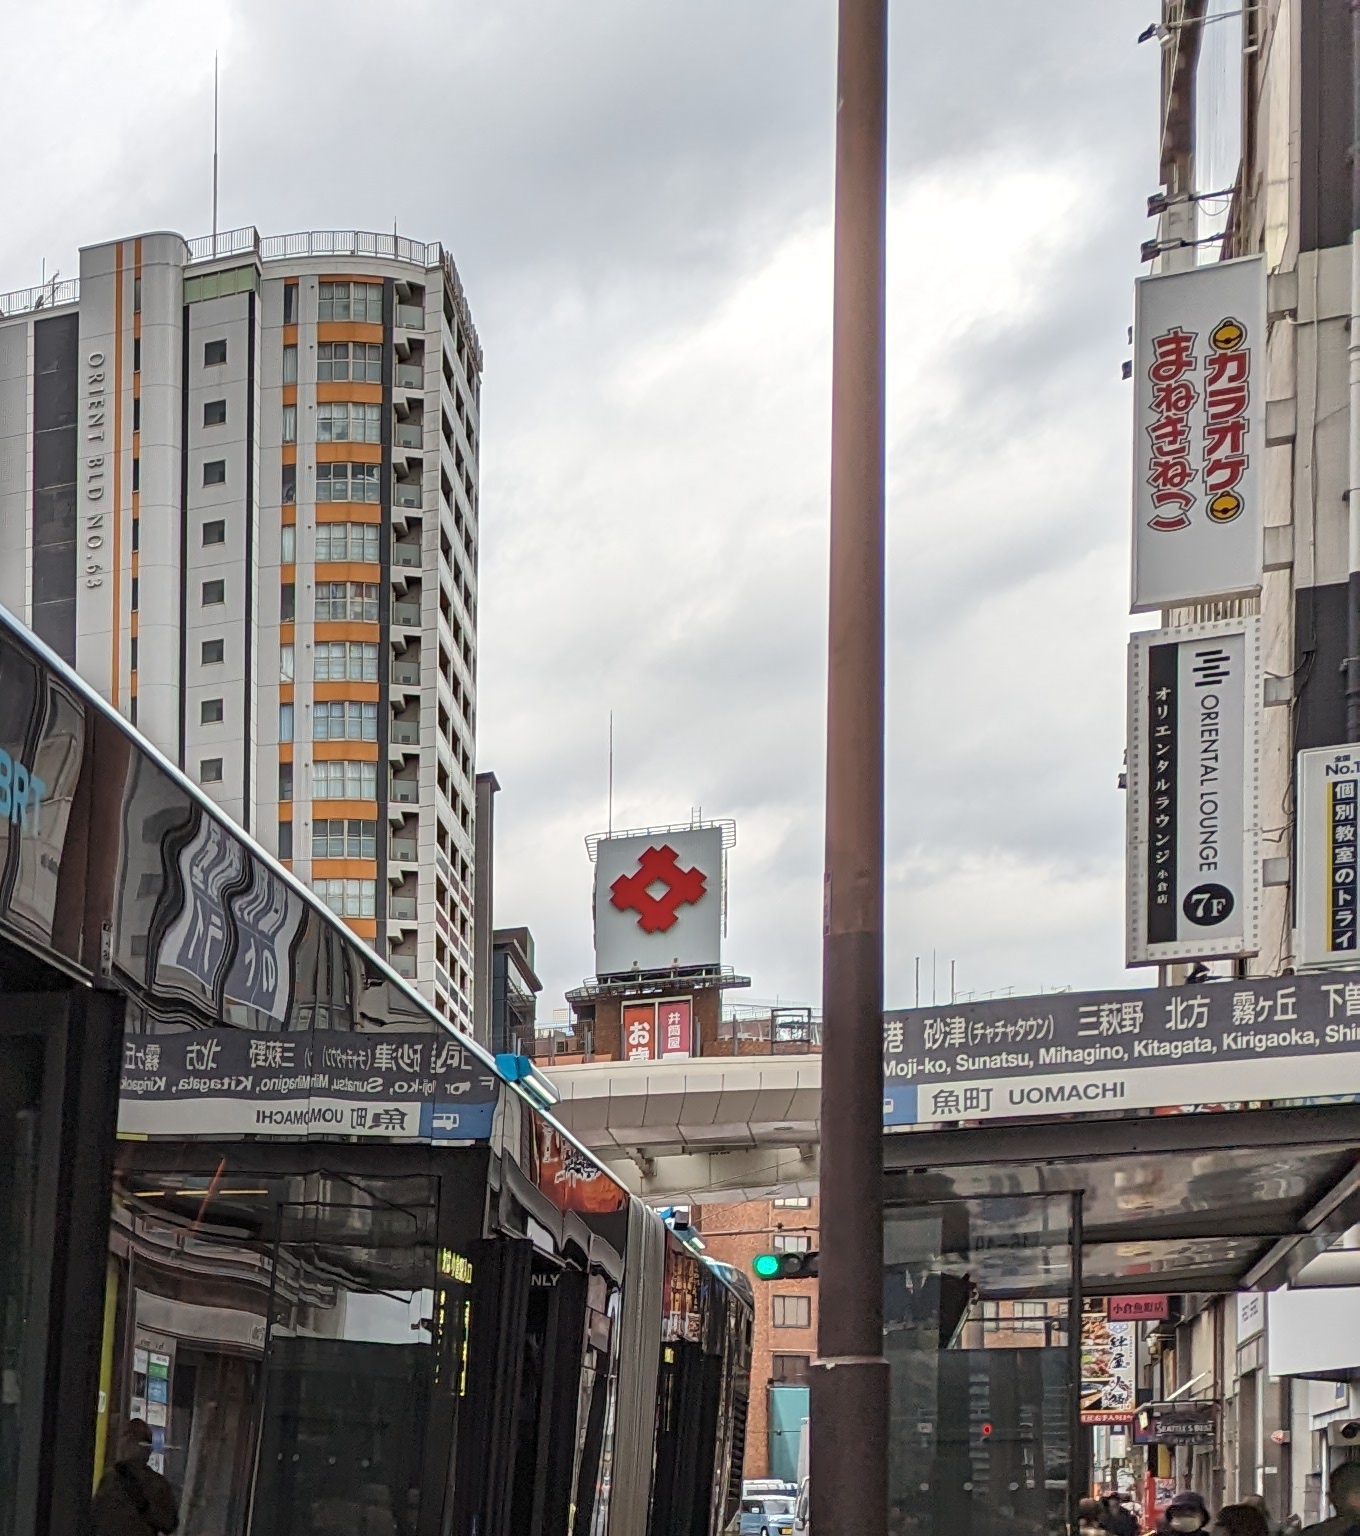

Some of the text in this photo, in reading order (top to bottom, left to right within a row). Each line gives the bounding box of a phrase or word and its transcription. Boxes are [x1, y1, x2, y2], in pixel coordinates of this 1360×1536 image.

[86, 352, 106, 590] ORIENT BLD NO.63
[1147, 326, 1199, 532] まねきねこ
[1203, 348, 1252, 496] カラオケ
[1154, 685, 1173, 905] オリエンタルラウンジ 小倉店
[1199, 693, 1220, 873] ORIENTAL LOUNGE
[1190, 892, 1227, 919] 7F
[1334, 782, 1356, 950] 個別教室のトライ
[923, 1015, 1055, 1050] 砂津(チャチャタウン)
[1077, 1001, 1144, 1037] 三萩野
[1165, 994, 1211, 1031] 北方
[956, 1052, 1034, 1072] Sunatsu,
[1039, 1043, 1129, 1066] Mihagino,
[1134, 1037, 1218, 1058] Kitagata,
[1223, 1028, 1320, 1052] Kirigaoka,
[1008, 1081, 1126, 1106] UOMACHI
[932, 1086, 994, 1116] 魚町
